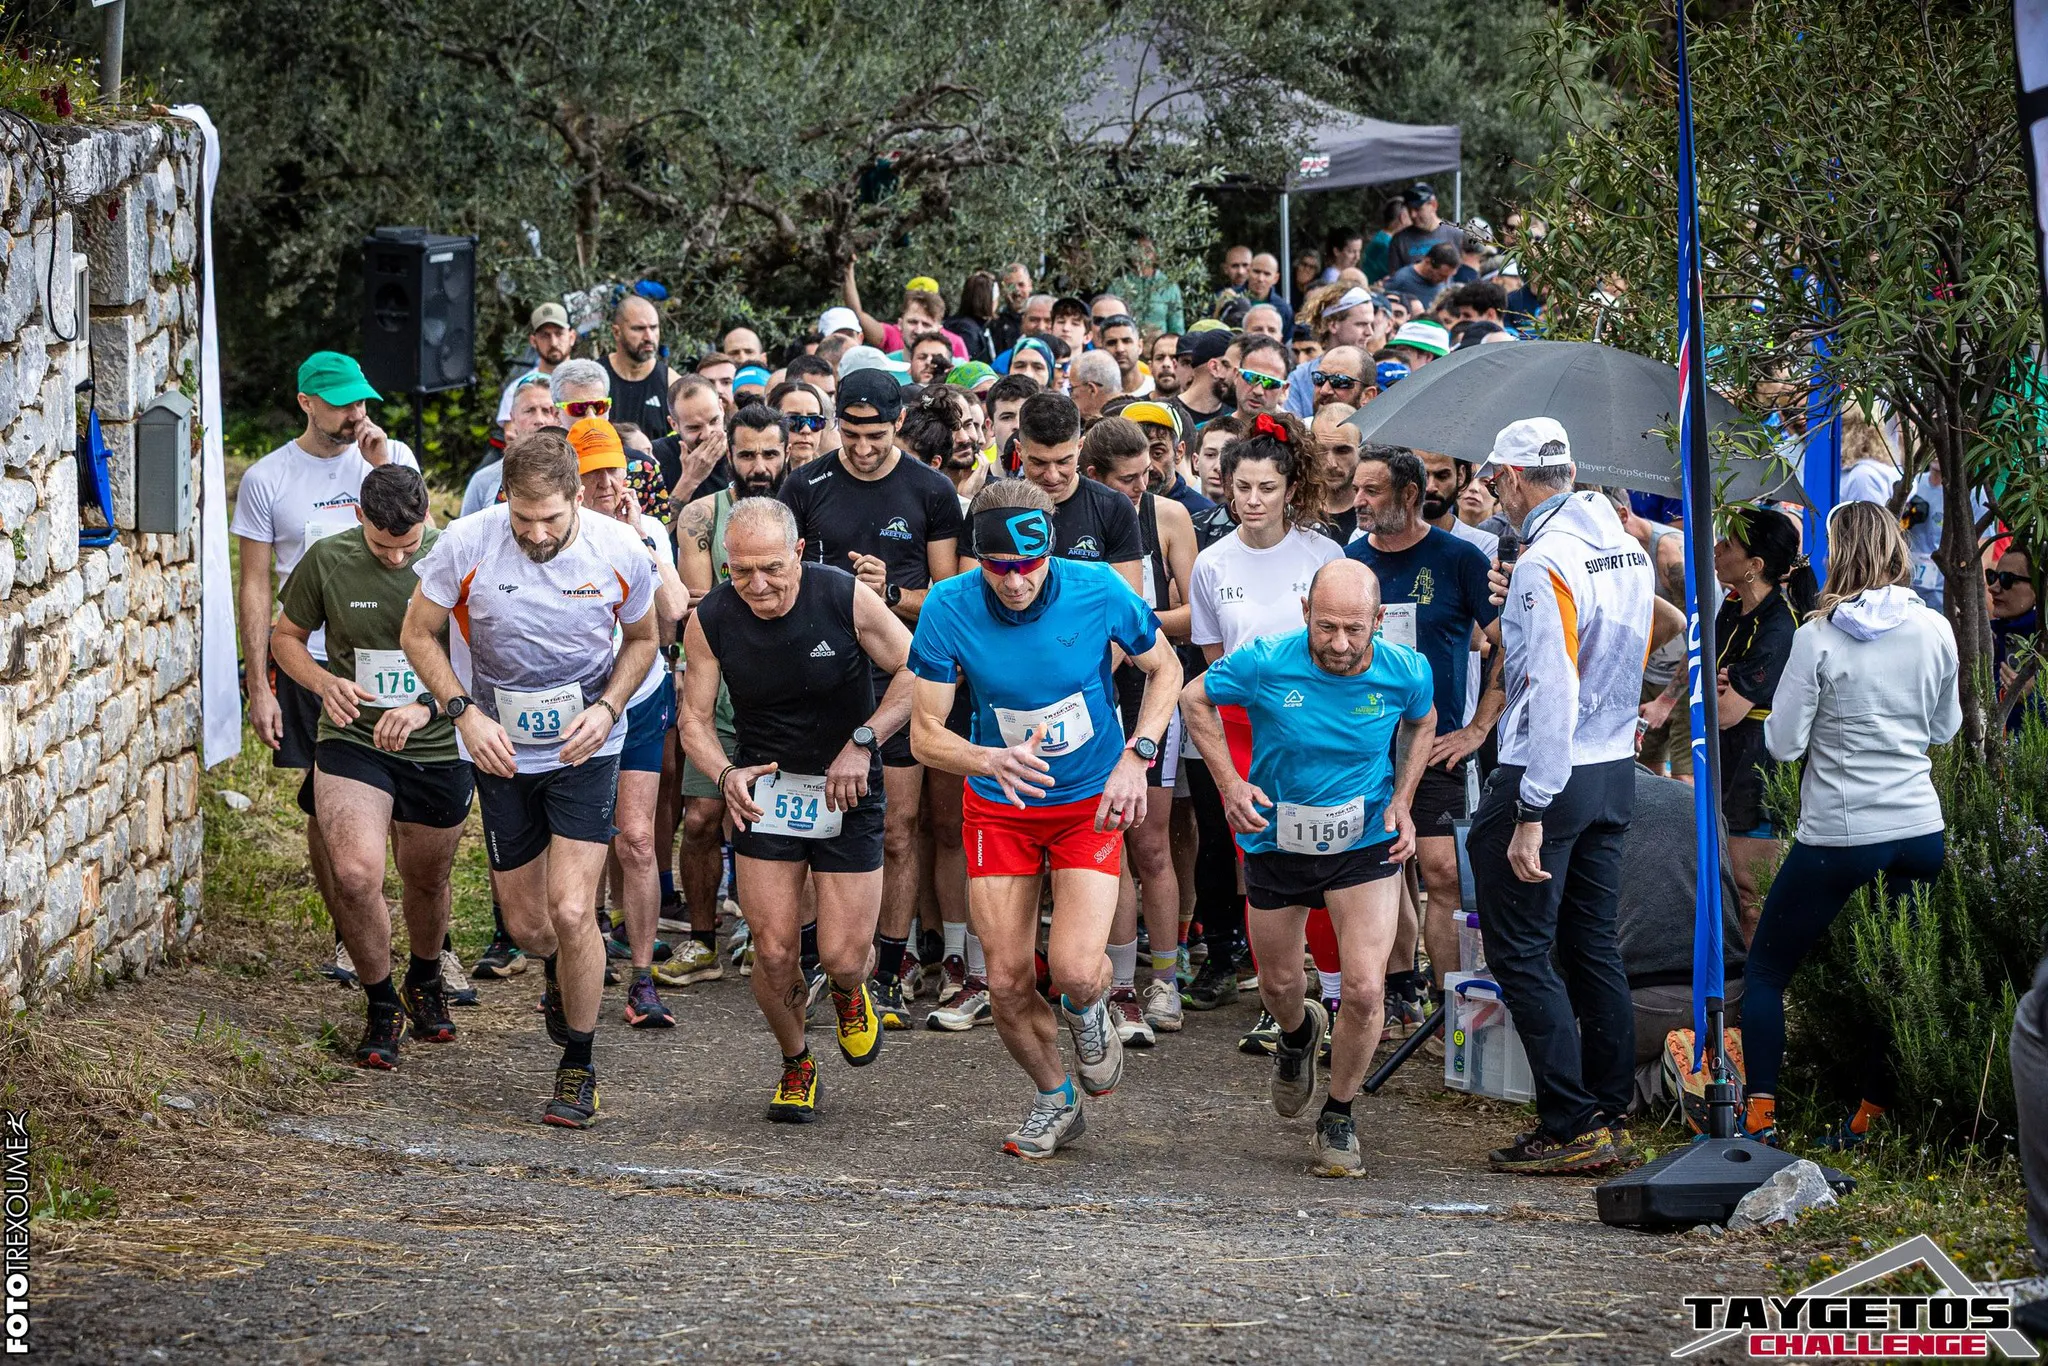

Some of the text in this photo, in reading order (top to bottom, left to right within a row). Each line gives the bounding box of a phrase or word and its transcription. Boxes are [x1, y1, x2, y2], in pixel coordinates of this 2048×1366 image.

[1578, 461, 1671, 482] Bayer CropScience
[313, 498, 359, 508] TAYGETOS
[350, 601, 378, 609] #PMTR
[810, 650, 836, 658] adidas
[374, 671, 416, 694] 176
[517, 709, 561, 732] 433
[775, 794, 819, 822] 534
[1293, 819, 1349, 842] 1156
